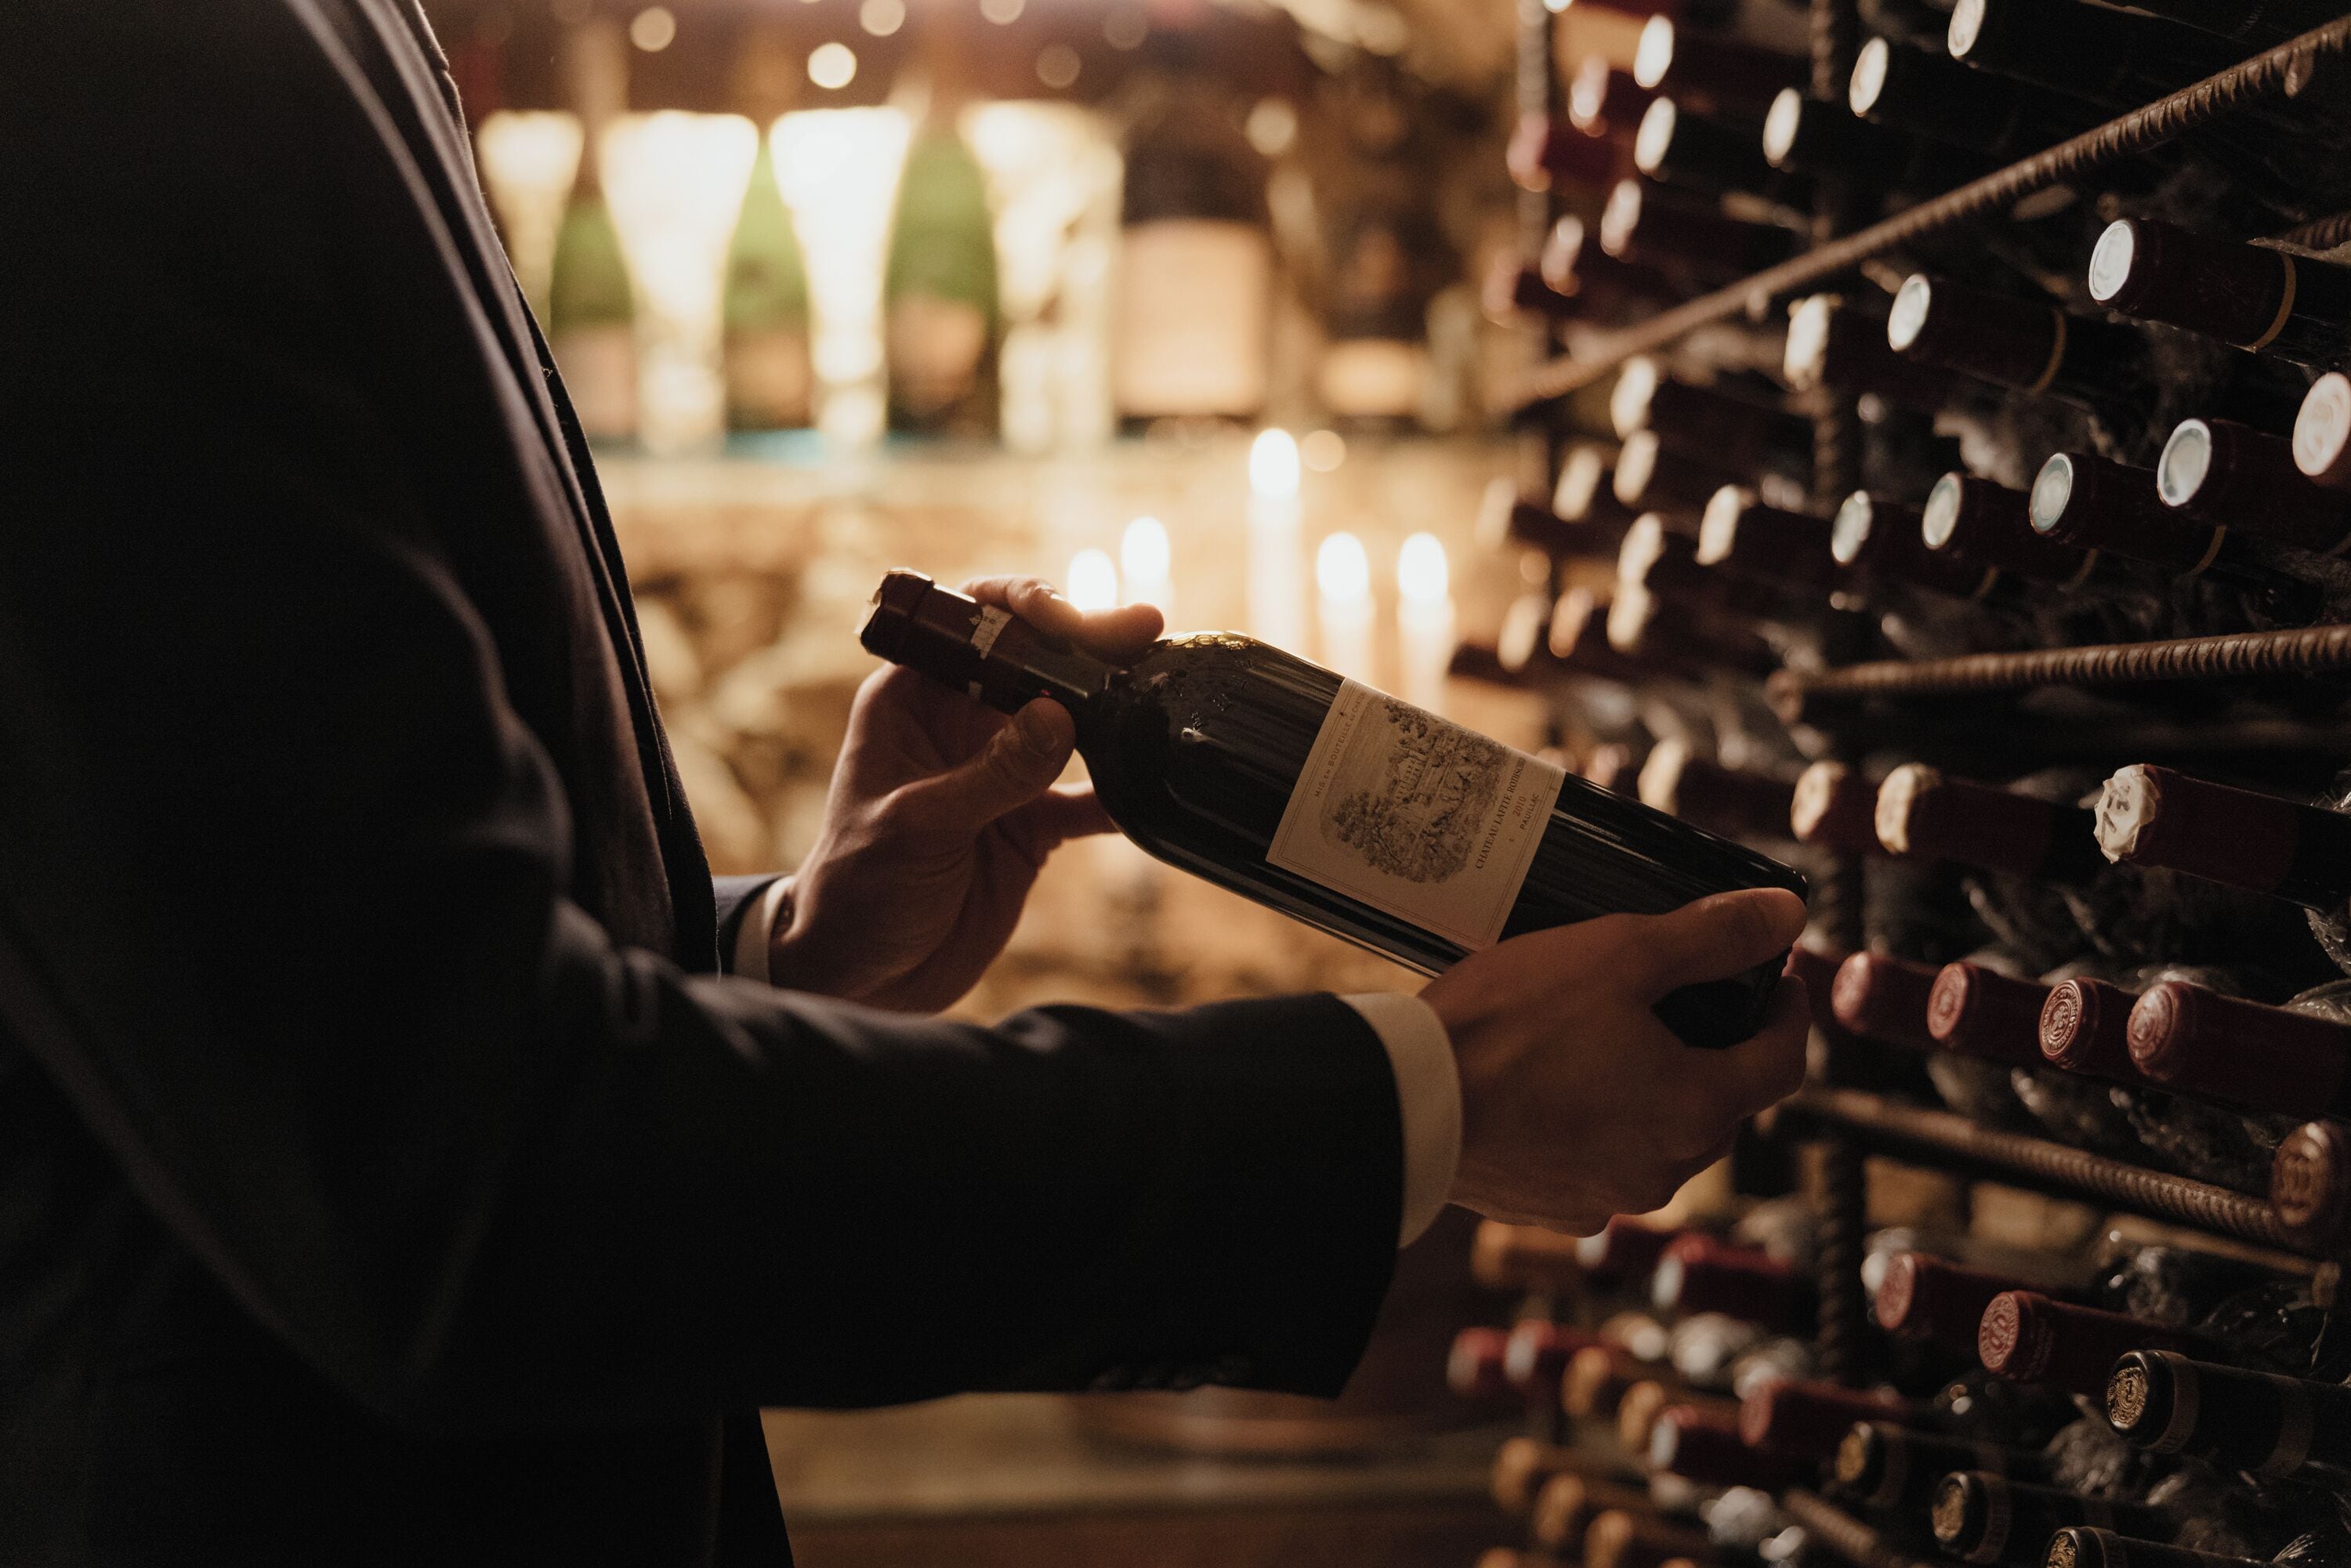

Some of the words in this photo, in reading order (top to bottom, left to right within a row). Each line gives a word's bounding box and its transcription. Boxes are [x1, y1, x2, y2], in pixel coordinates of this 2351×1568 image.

[1314, 781, 1325, 798] MIS
[1328, 722, 1352, 766] BOUTEILLE
[1475, 824, 1499, 870] CHATEAU
[1495, 793, 1512, 824] LAFITE
[1512, 795, 1527, 817] 2010
[1519, 794, 1539, 830] PAUILLAC
